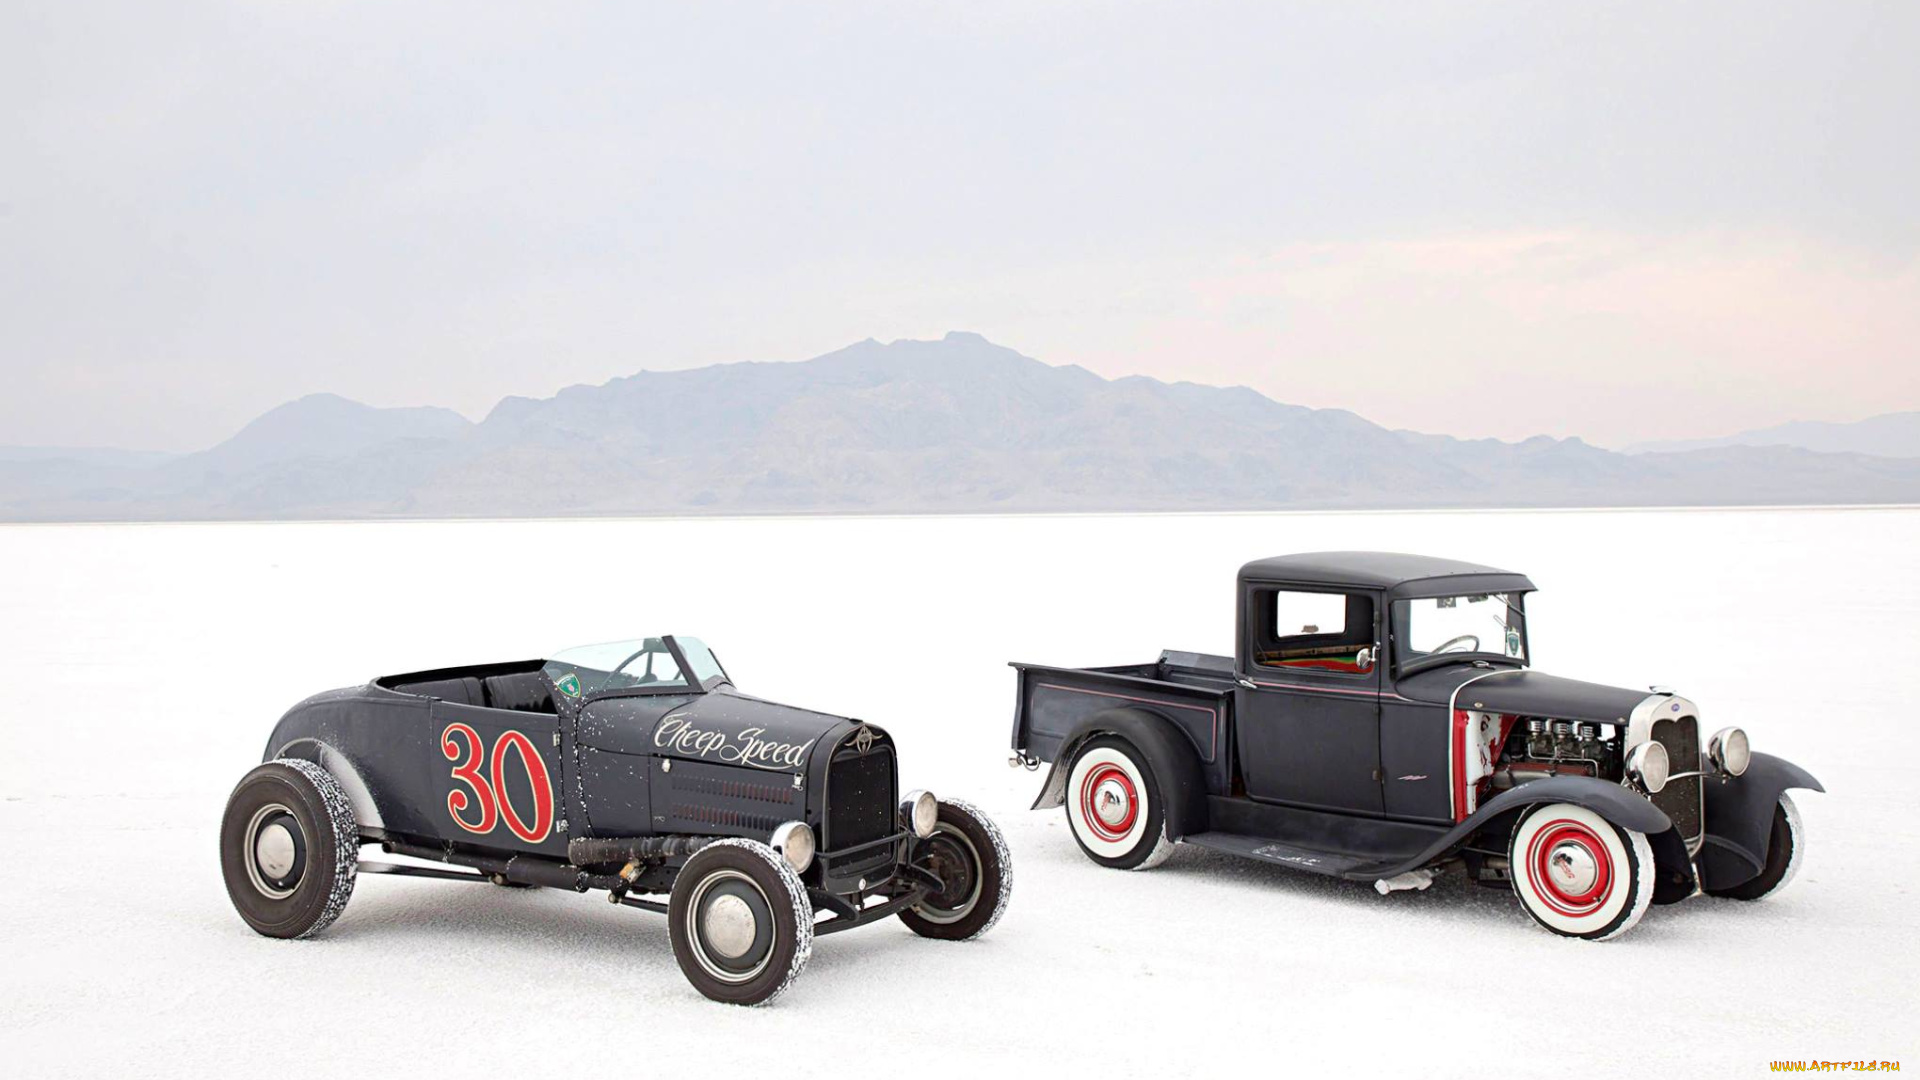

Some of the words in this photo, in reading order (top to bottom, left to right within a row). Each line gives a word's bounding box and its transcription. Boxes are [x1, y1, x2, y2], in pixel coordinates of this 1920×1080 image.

[441, 722, 554, 844] 30
[654, 712, 726, 757] Cheep
[719, 727, 815, 770] Speed
